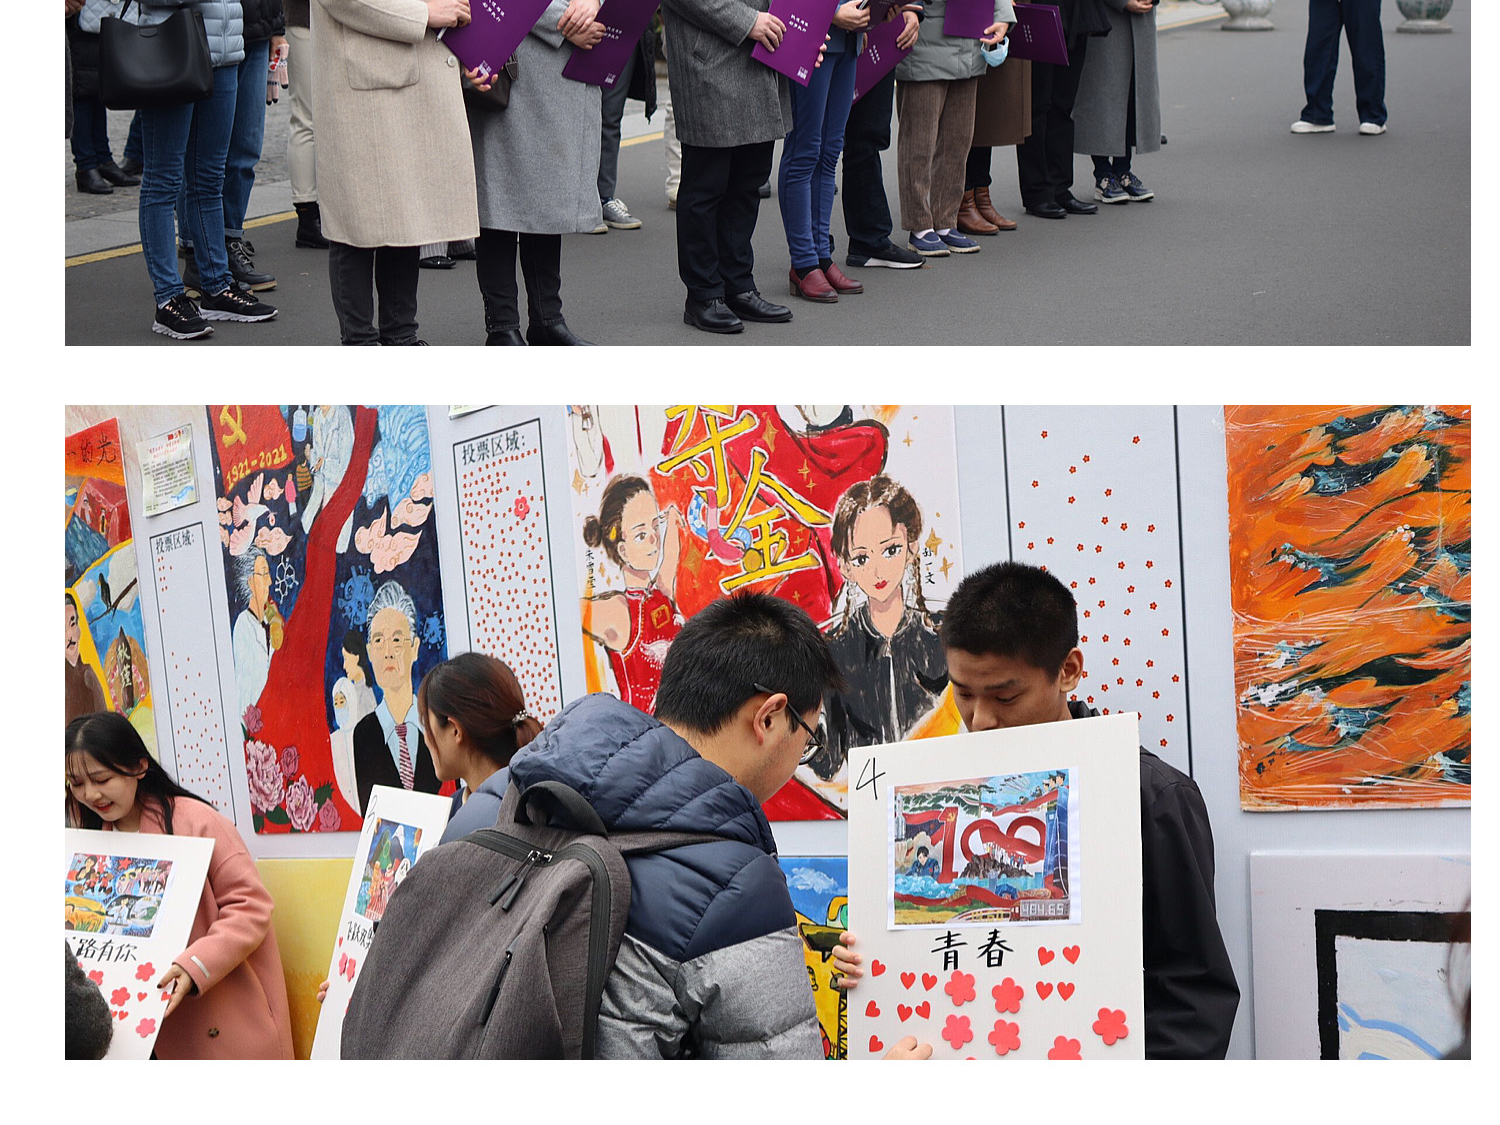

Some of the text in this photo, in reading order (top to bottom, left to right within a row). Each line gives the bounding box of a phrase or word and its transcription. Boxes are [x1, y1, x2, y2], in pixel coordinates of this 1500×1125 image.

[227, 444, 288, 490] 1921-2021
[462, 430, 526, 465] 投票区域：
[922, 547, 936, 585] 孙一文
[856, 757, 886, 801] 4
[65, 935, 138, 963] 路有你
[931, 928, 1014, 971] 青春
